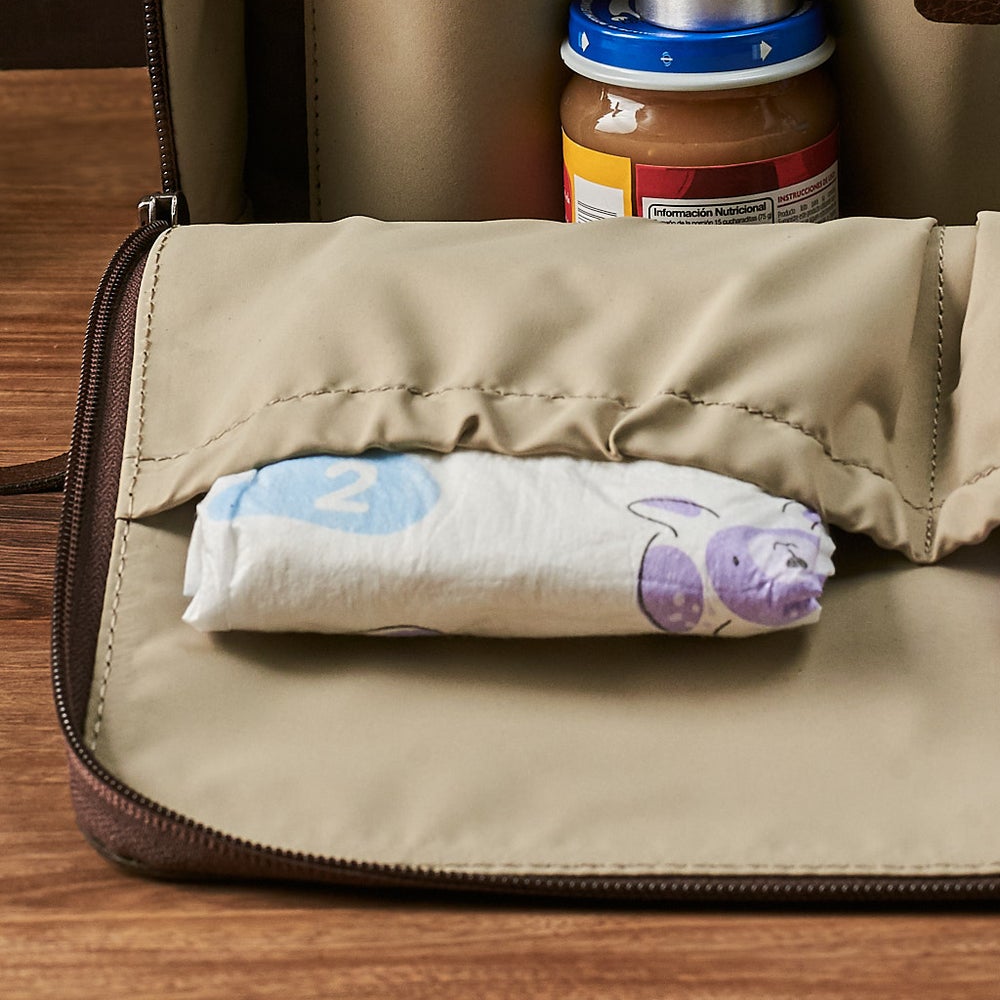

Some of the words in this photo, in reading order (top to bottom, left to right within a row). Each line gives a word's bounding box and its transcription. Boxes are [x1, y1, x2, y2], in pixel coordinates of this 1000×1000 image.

[778, 180, 823, 203] INSTRUCCIONES
[653, 206, 712, 218] Información
[715, 201, 767, 217] Nutricional
[315, 459, 378, 513] 2
